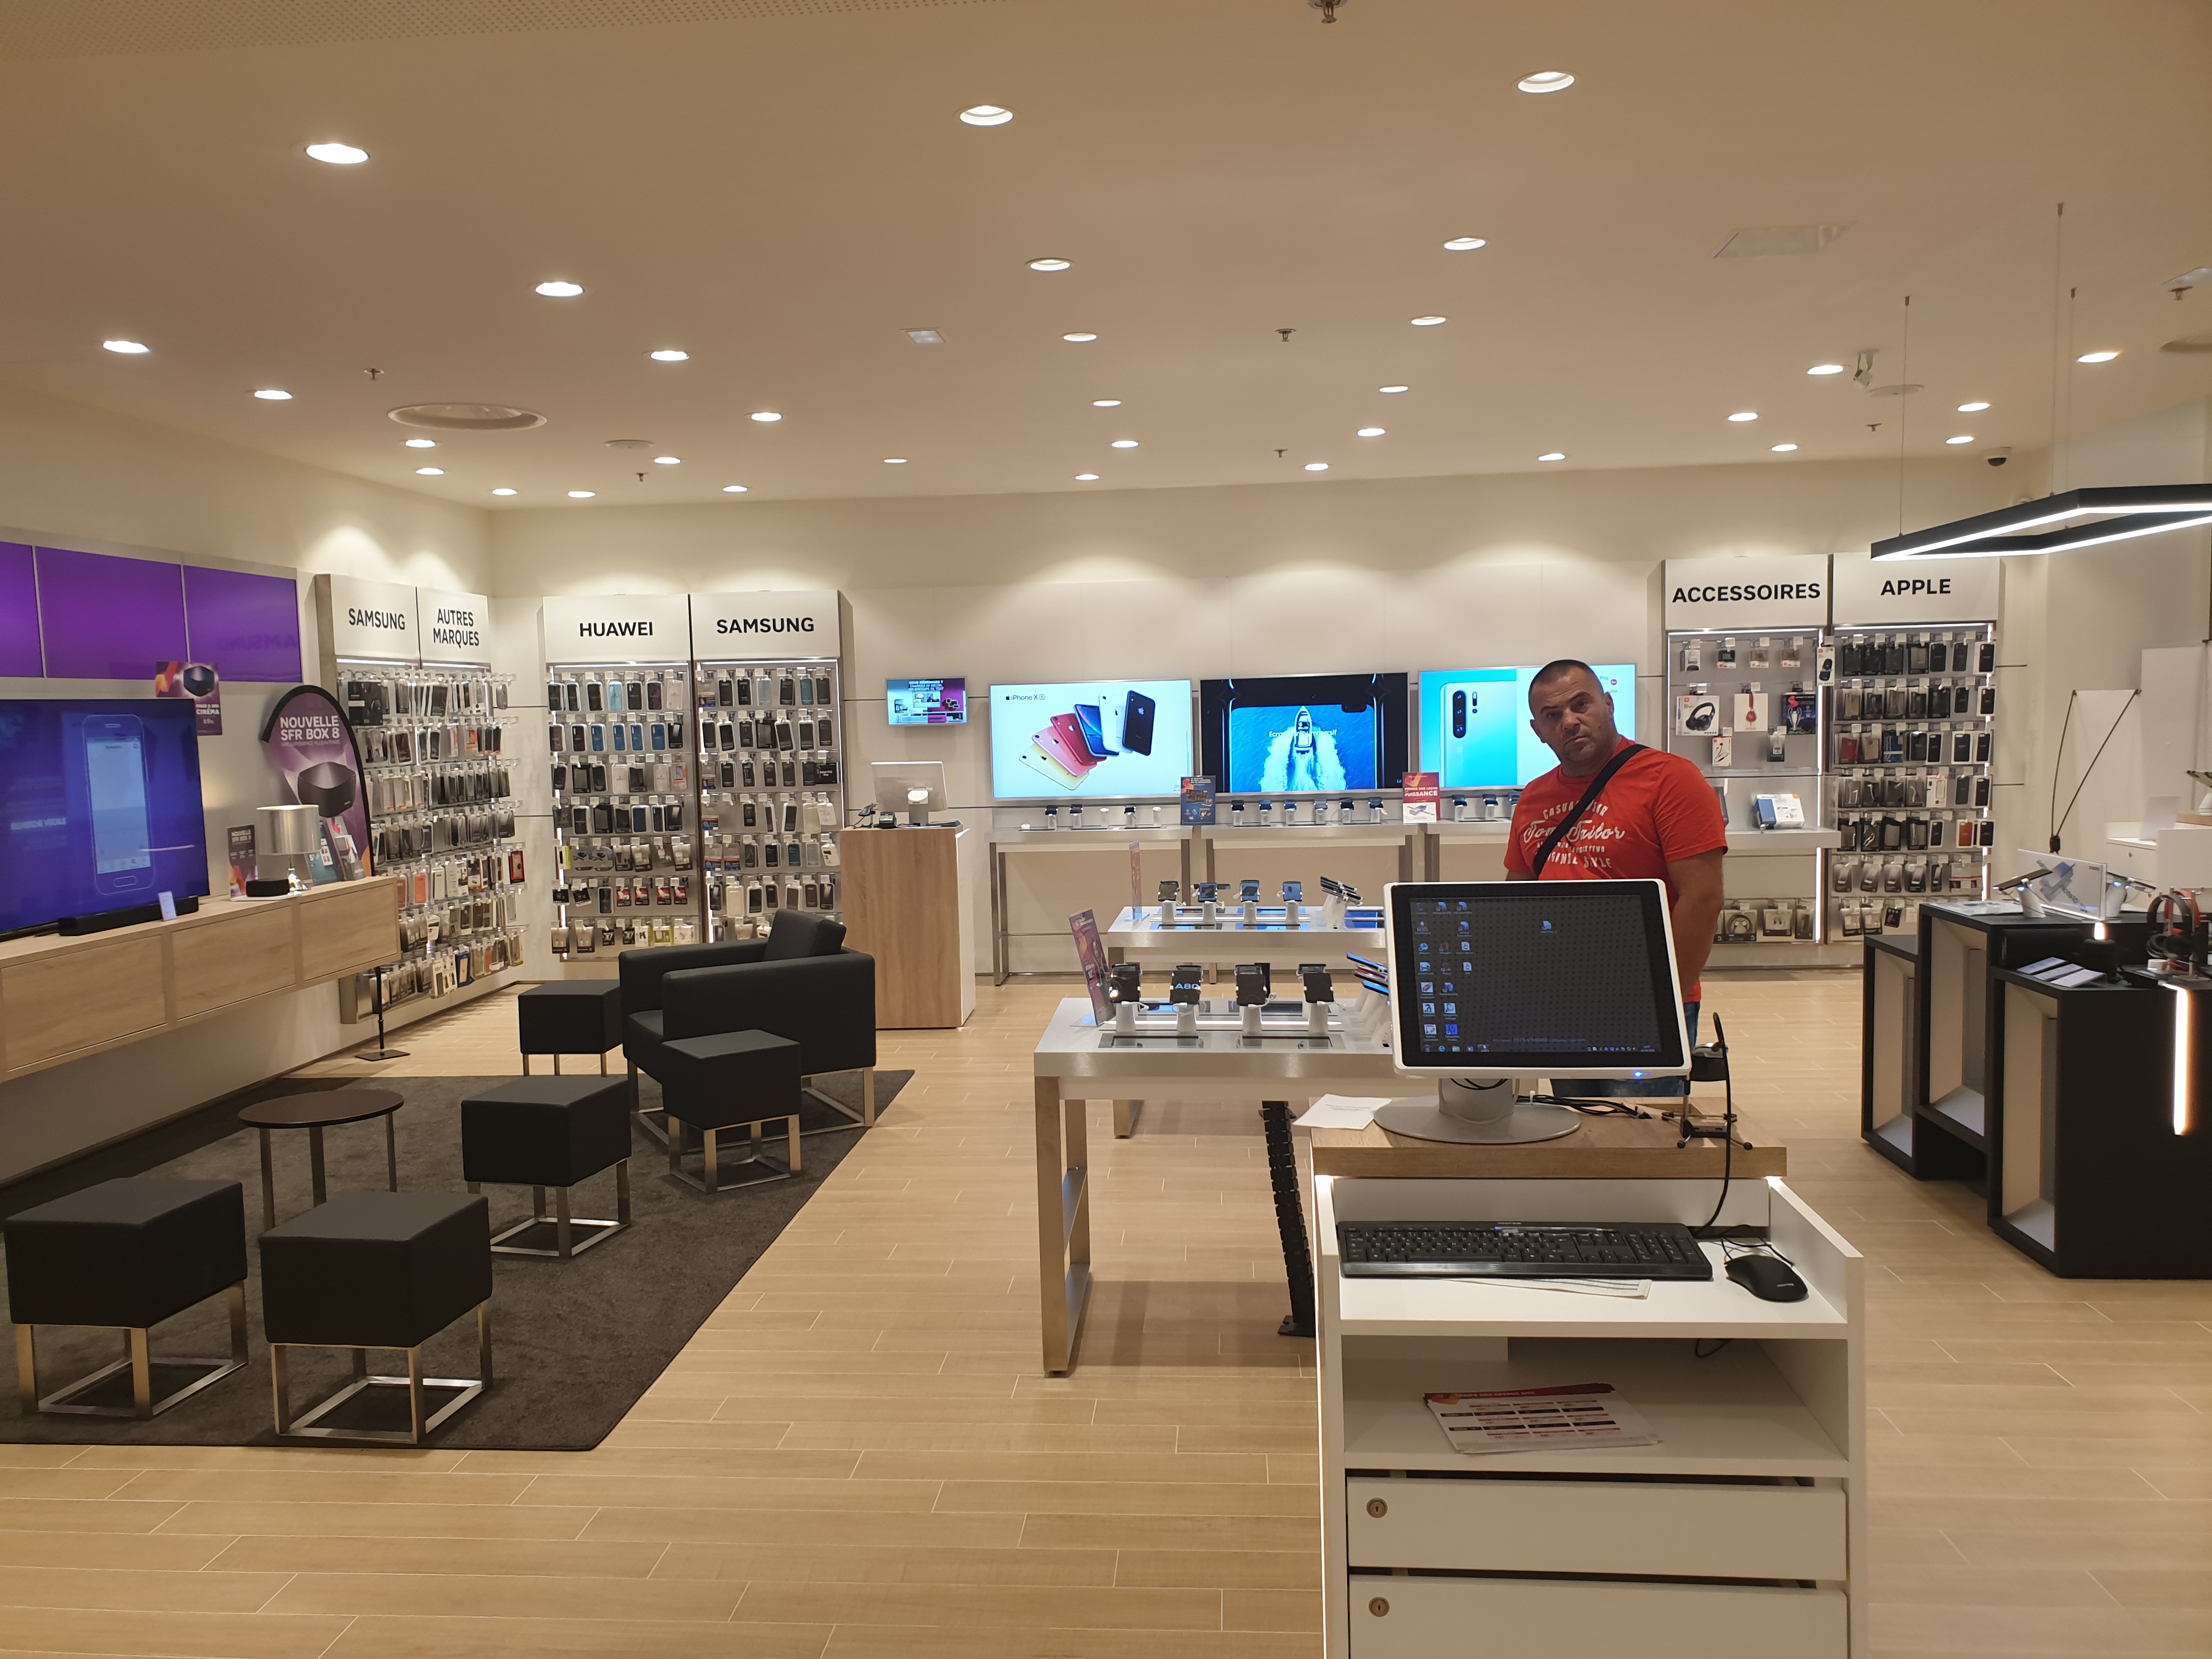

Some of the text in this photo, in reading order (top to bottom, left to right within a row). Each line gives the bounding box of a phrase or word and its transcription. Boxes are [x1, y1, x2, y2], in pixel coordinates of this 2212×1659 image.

[1672, 583, 1820, 603] ACCESSOIRES
[1880, 579, 1951, 595] APPLE
[348, 608, 405, 630] SAMSUNG
[437, 608, 474, 627] AUTRES
[716, 617, 814, 634] SAMSUNG
[433, 628, 479, 648] MARQUES
[579, 622, 653, 637] HUAWEI
[280, 715, 339, 729] NOUVELLE
[280, 727, 340, 741] SFR BOX 8
[1543, 799, 1579, 820] CASUA
[1523, 820, 1625, 843] Tom Tailor
